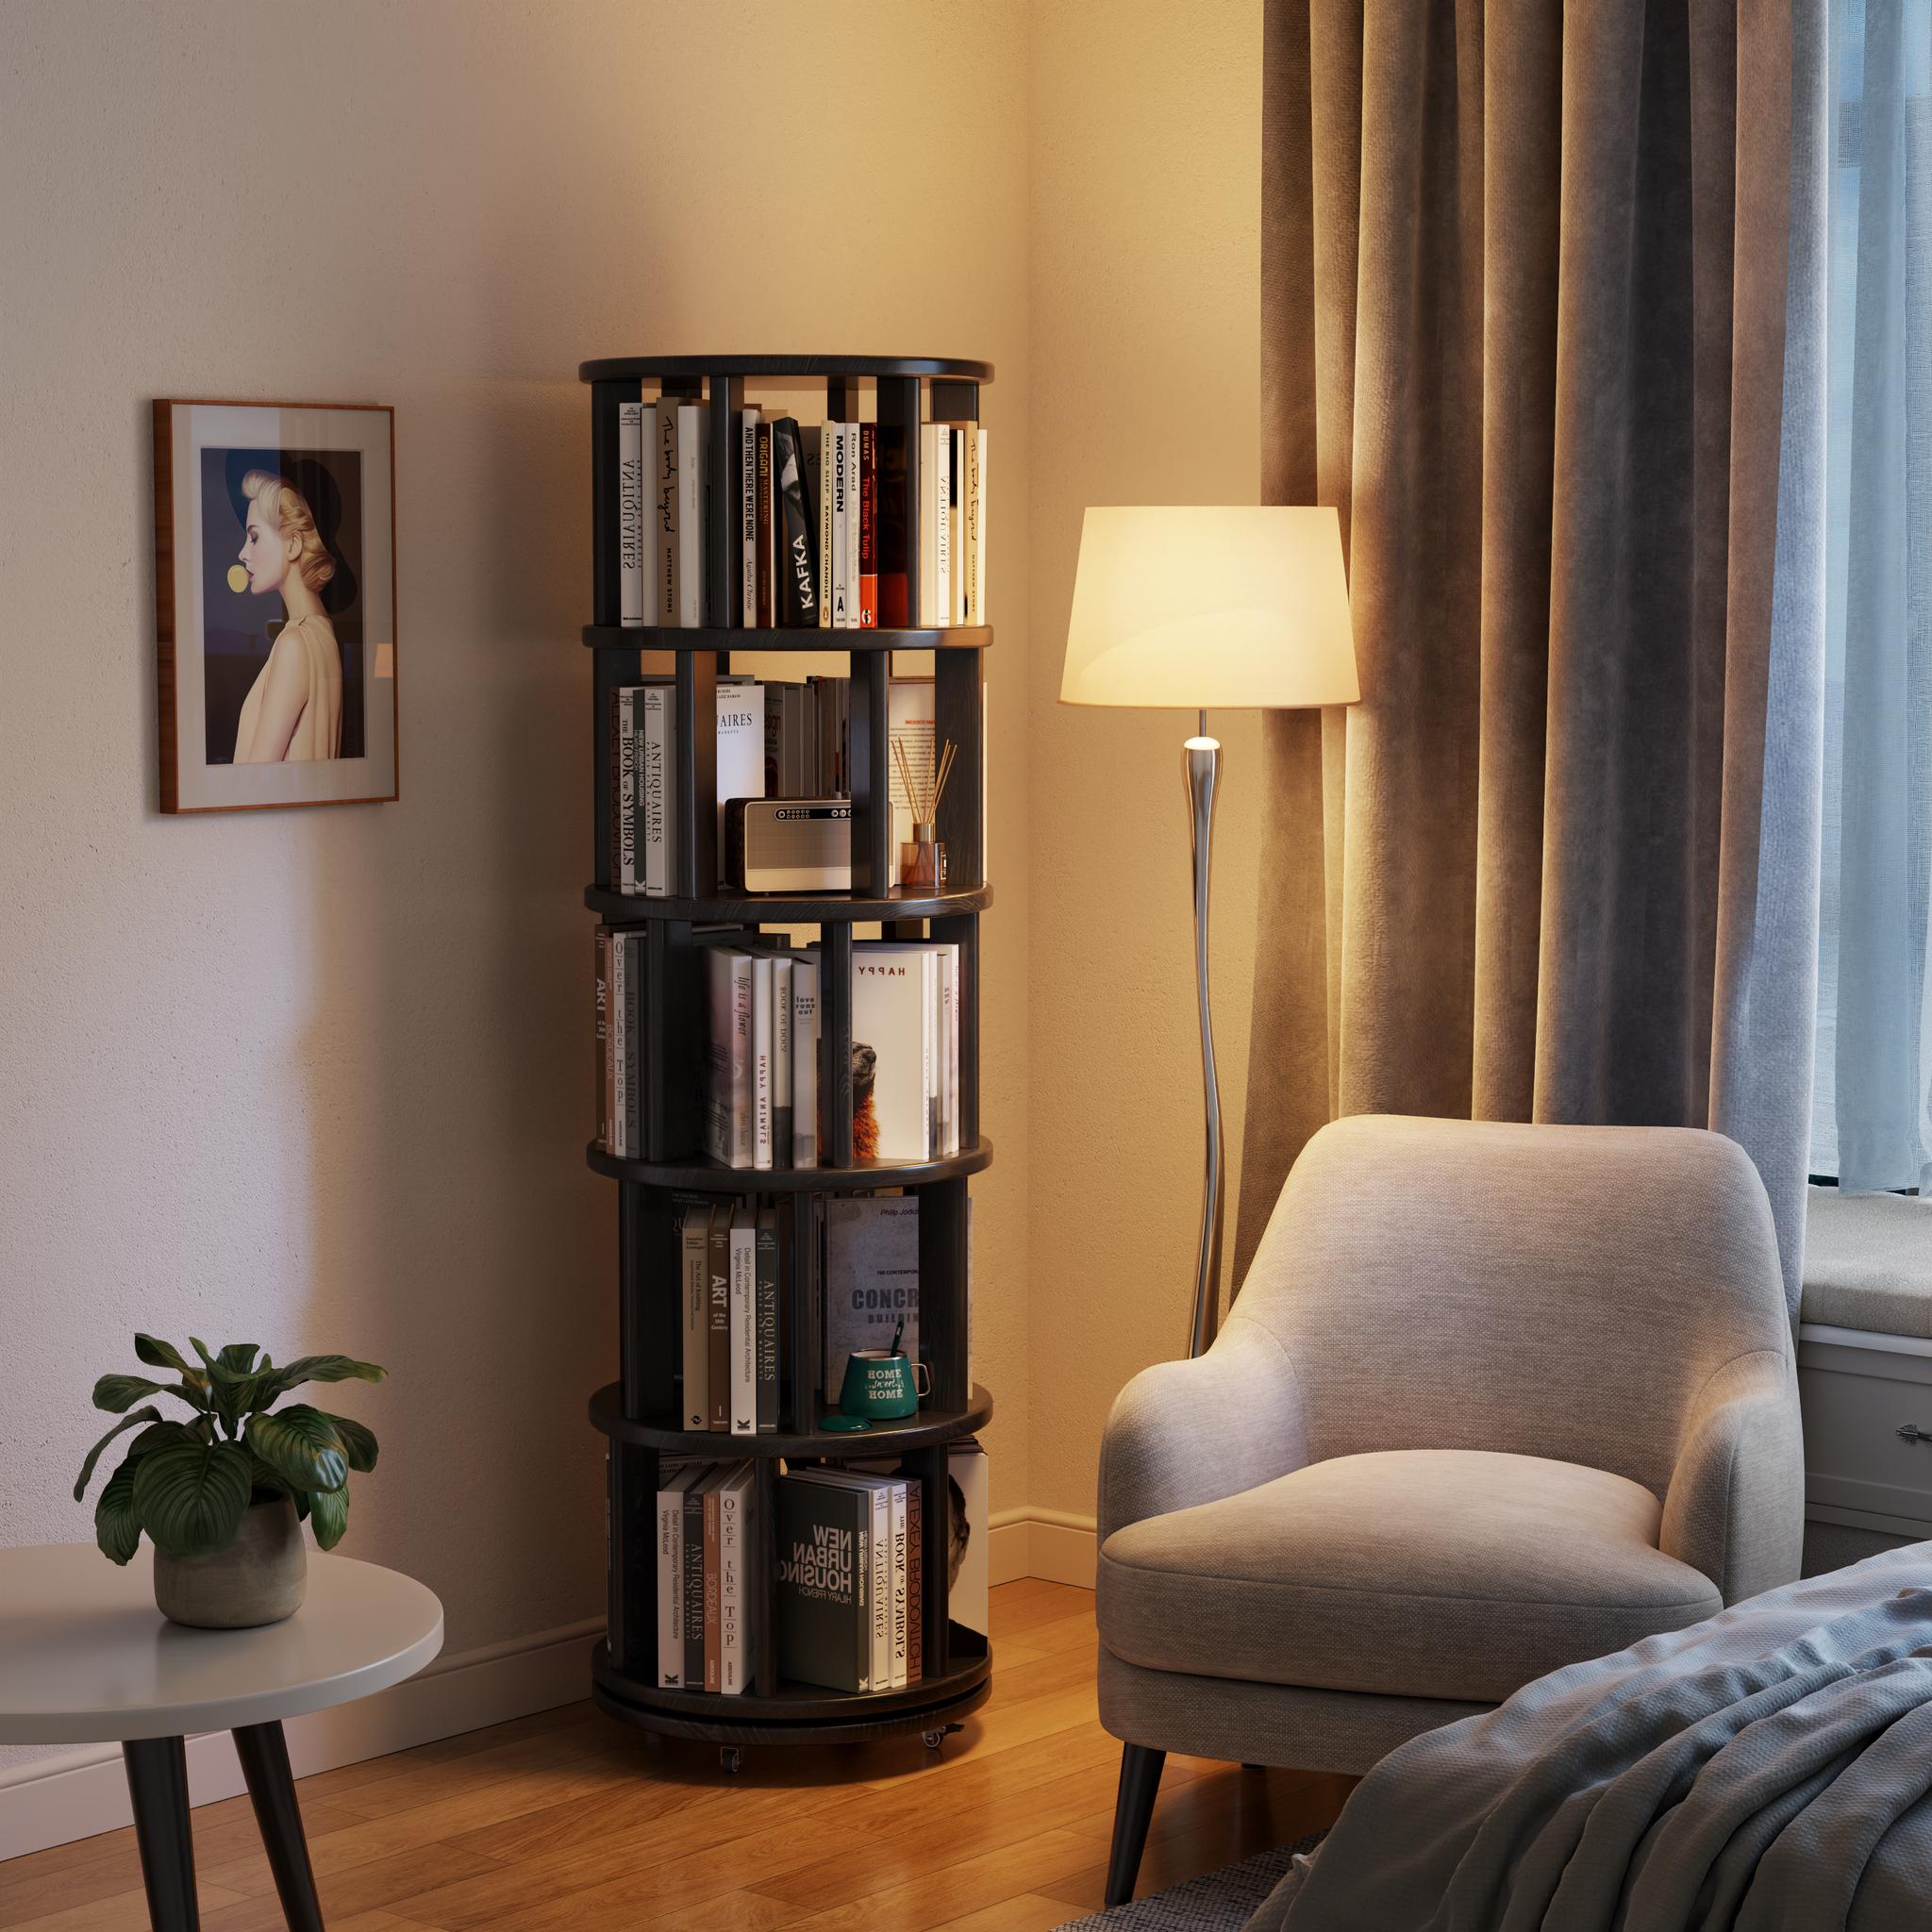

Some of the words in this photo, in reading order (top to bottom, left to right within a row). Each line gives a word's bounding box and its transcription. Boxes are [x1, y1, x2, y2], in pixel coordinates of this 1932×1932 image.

[744, 427, 754, 444] AND
[744, 445, 754, 467] THEN
[758, 436, 769, 476] ORIGAMI
[744, 468, 754, 493] THERE
[836, 435, 844, 512] MODERN
[745, 495, 755, 519] WERE
[745, 520, 755, 541] NONE
[861, 534, 870, 559] Tulip
[792, 534, 814, 609] KAFKA
[623, 737, 634, 778] BOOK
[623, 781, 629, 791] OF
[650, 741, 662, 842] ANTIQUAIRES
[623, 793, 635, 866] SYMBOLS
[734, 976, 750, 991] life
[625, 991, 635, 1035] BOOK
[734, 1008, 751, 1036] flower
[626, 1052, 637, 1129] SYMBOLS
[740, 1112, 748, 1127] chris
[740, 1128, 748, 1146] choice
[734, 1247, 742, 1270] Virginia
[743, 1248, 752, 1265] Detail
[711, 1274, 727, 1307] ART
[734, 1271, 742, 1295] McLeod
[742, 1272, 752, 1314] Contemporary
[852, 1288, 919, 1310] CONCR
[762, 1280, 775, 1381] ANTIQUAIRES
[868, 1312, 919, 1324] BUILDIN
[867, 1369, 902, 1379] HOME
[868, 1389, 903, 1400] HOME
[660, 1509, 669, 1531] Virginia
[724, 1498, 735, 1545] Over
[671, 1533, 679, 1574] Contemporary
[725, 1559, 734, 1594] the
[690, 1543, 703, 1641] ANTIQUAIRES
[706, 1573, 717, 1624] BORDEAUX
[724, 1606, 735, 1646] Top
